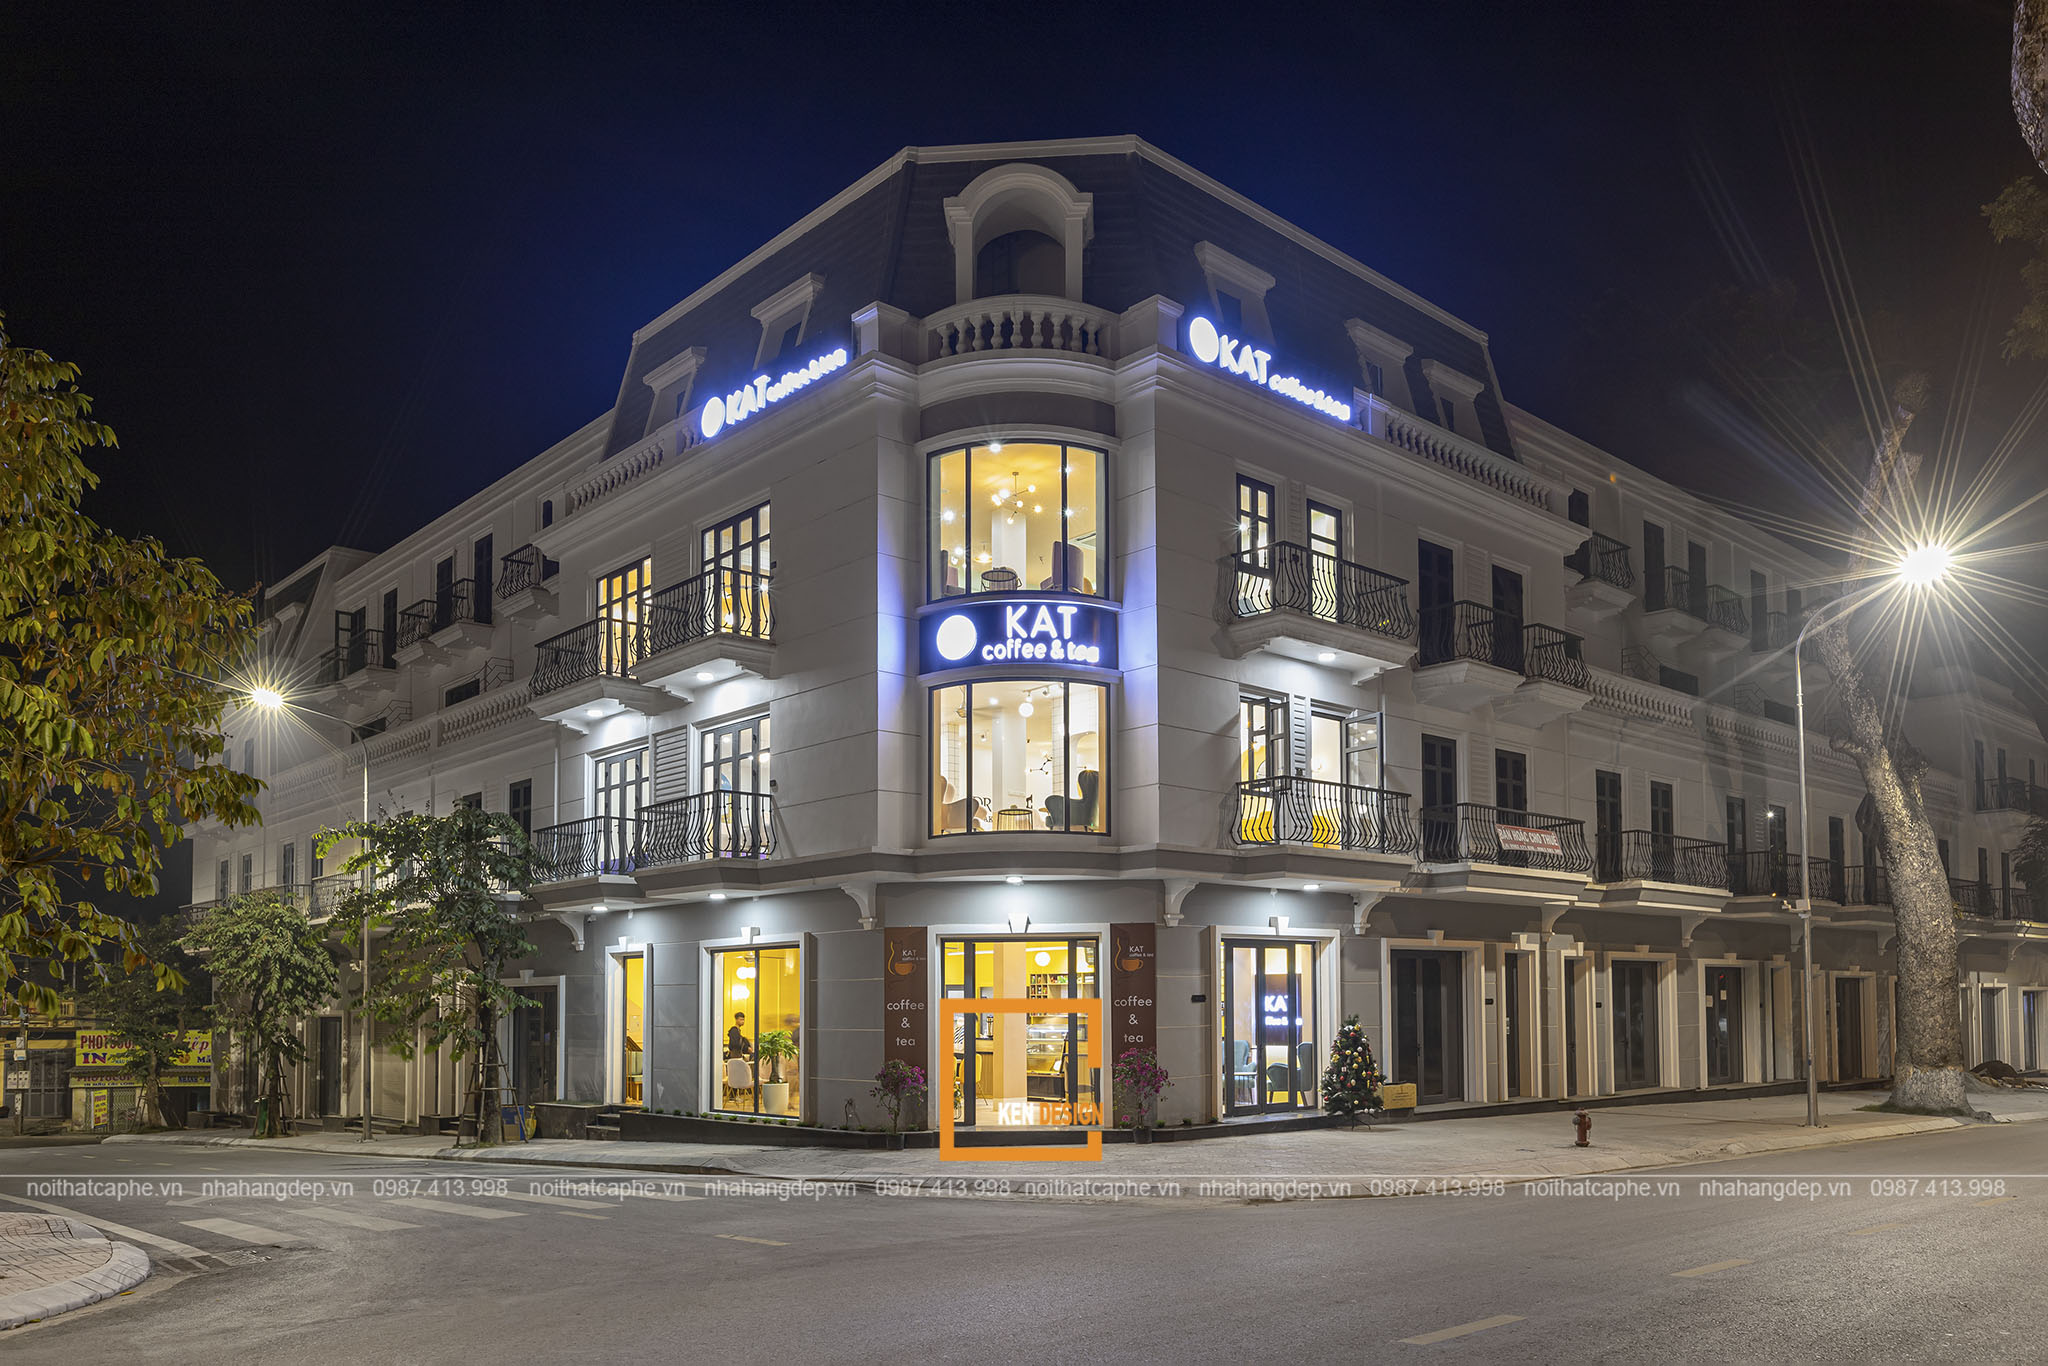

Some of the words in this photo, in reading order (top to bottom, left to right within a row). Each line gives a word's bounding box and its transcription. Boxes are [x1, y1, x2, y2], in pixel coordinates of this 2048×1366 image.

[1219, 334, 1271, 384] KAT
[726, 375, 771, 425] KAT
[1006, 605, 1078, 639] KAT
[982, 638, 1047, 660] coffee
[1050, 640, 1064, 660] &
[1067, 641, 1099, 663] tea
[902, 949, 916, 957] KAT
[887, 999, 925, 1011] coffee
[1114, 995, 1153, 1007] coffee
[1264, 994, 1289, 1012] KA
[901, 1017, 911, 1028] &
[1128, 1013, 1138, 1025] &
[896, 1036, 916, 1046] tea
[1124, 1033, 1144, 1043] tea
[82, 1052, 108, 1064] IN
